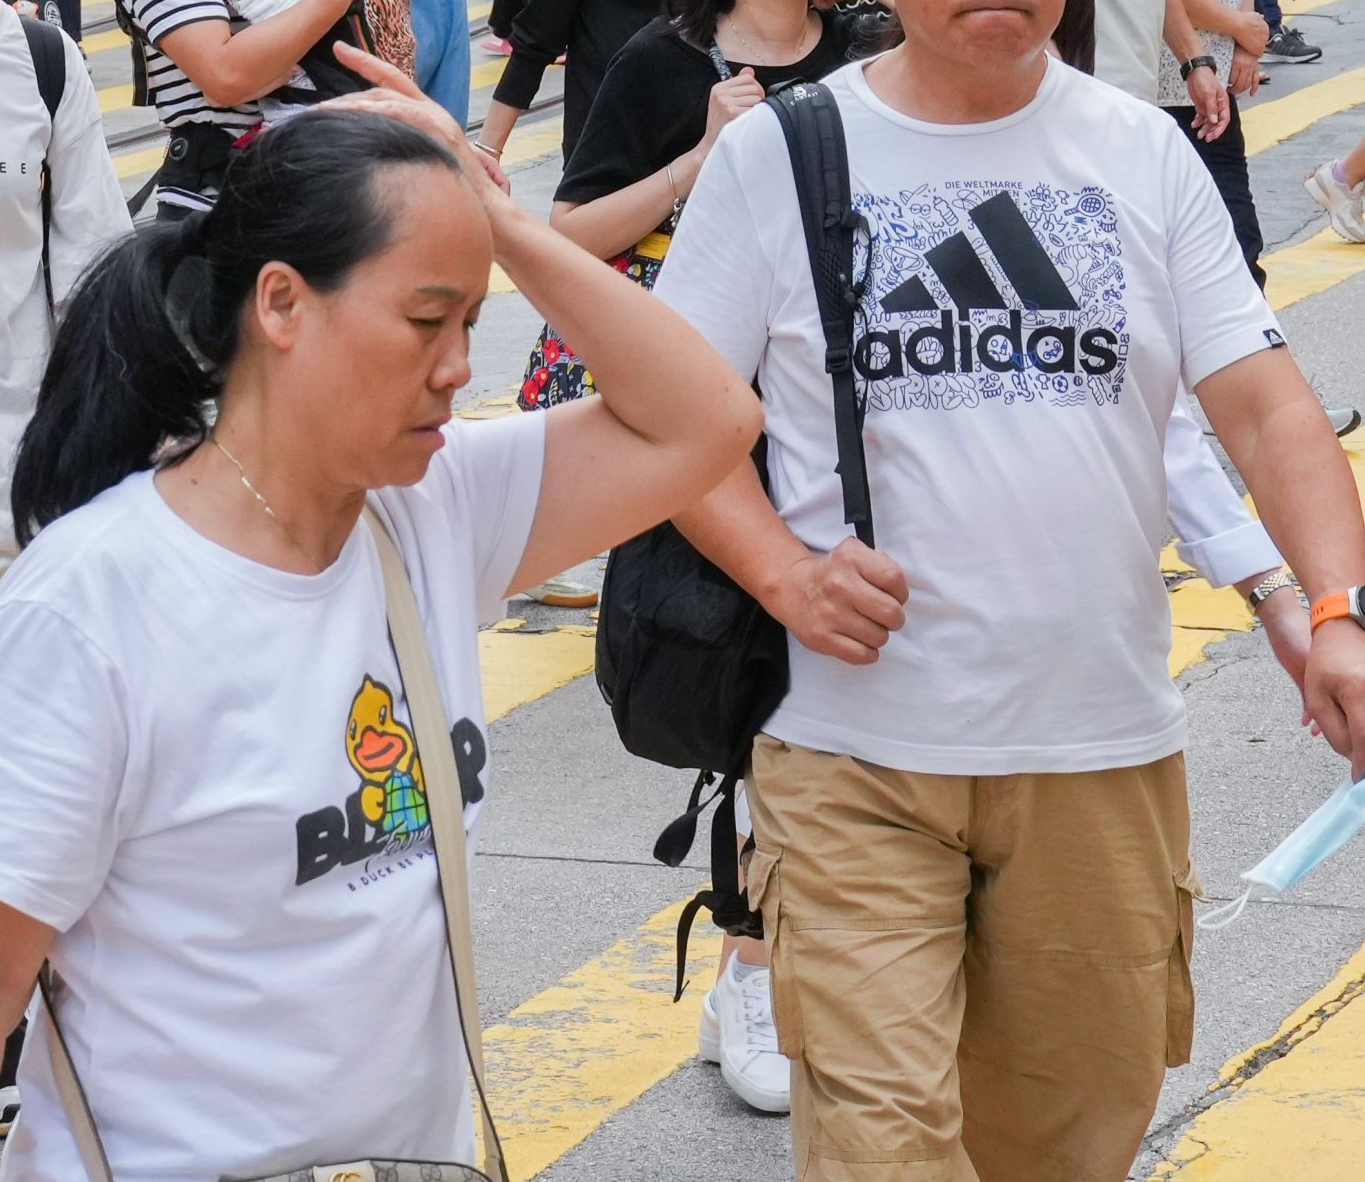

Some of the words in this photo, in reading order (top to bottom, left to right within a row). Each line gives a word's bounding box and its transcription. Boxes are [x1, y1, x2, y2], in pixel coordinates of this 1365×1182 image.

[945, 181, 961, 190] DIE
[964, 180, 1024, 190] WELTMARKE
[854, 309, 1118, 380] adidas
